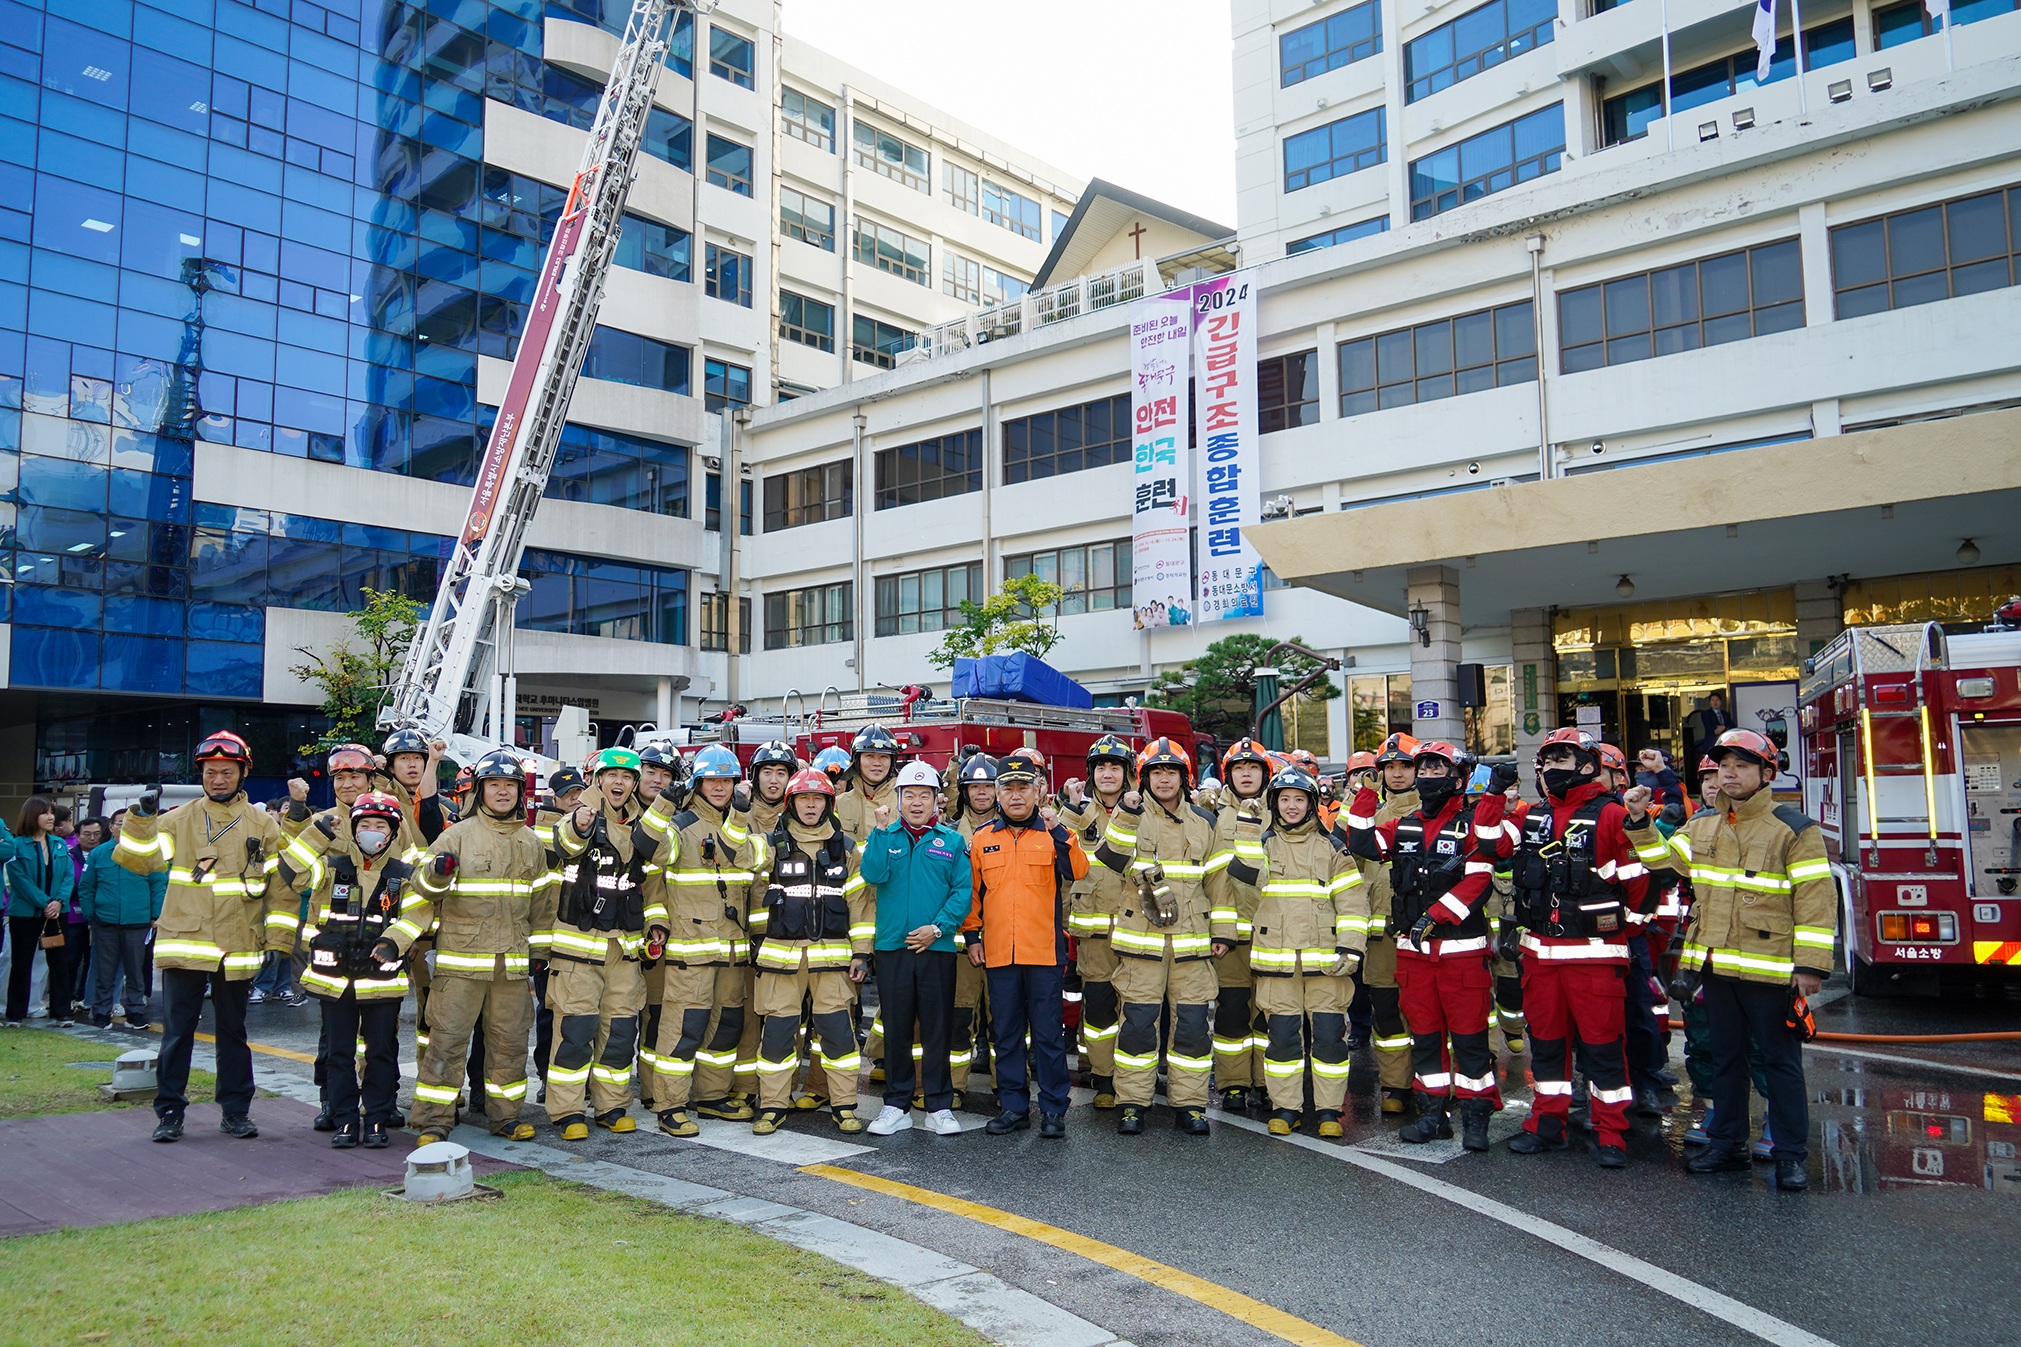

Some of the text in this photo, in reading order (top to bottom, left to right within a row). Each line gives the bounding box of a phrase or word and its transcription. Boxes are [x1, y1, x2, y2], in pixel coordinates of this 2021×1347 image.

[1199, 283, 1249, 312] 2024
[1133, 315, 1178, 336] 준비된 오늘
[1140, 326, 1187, 349] 안전한 내일
[1136, 395, 1176, 435] 안전
[480, 412, 515, 506] 서울특별시 소방재난본부
[1135, 436, 1176, 474] 한국
[1135, 477, 1176, 514] 훈련
[1211, 566, 1258, 582] 동대문구
[1211, 580, 1257, 597] 동대문소방서
[1213, 594, 1258, 611] 경희의료원
[1423, 709, 1434, 718] 23
[1894, 946, 1943, 960] 서울소방
